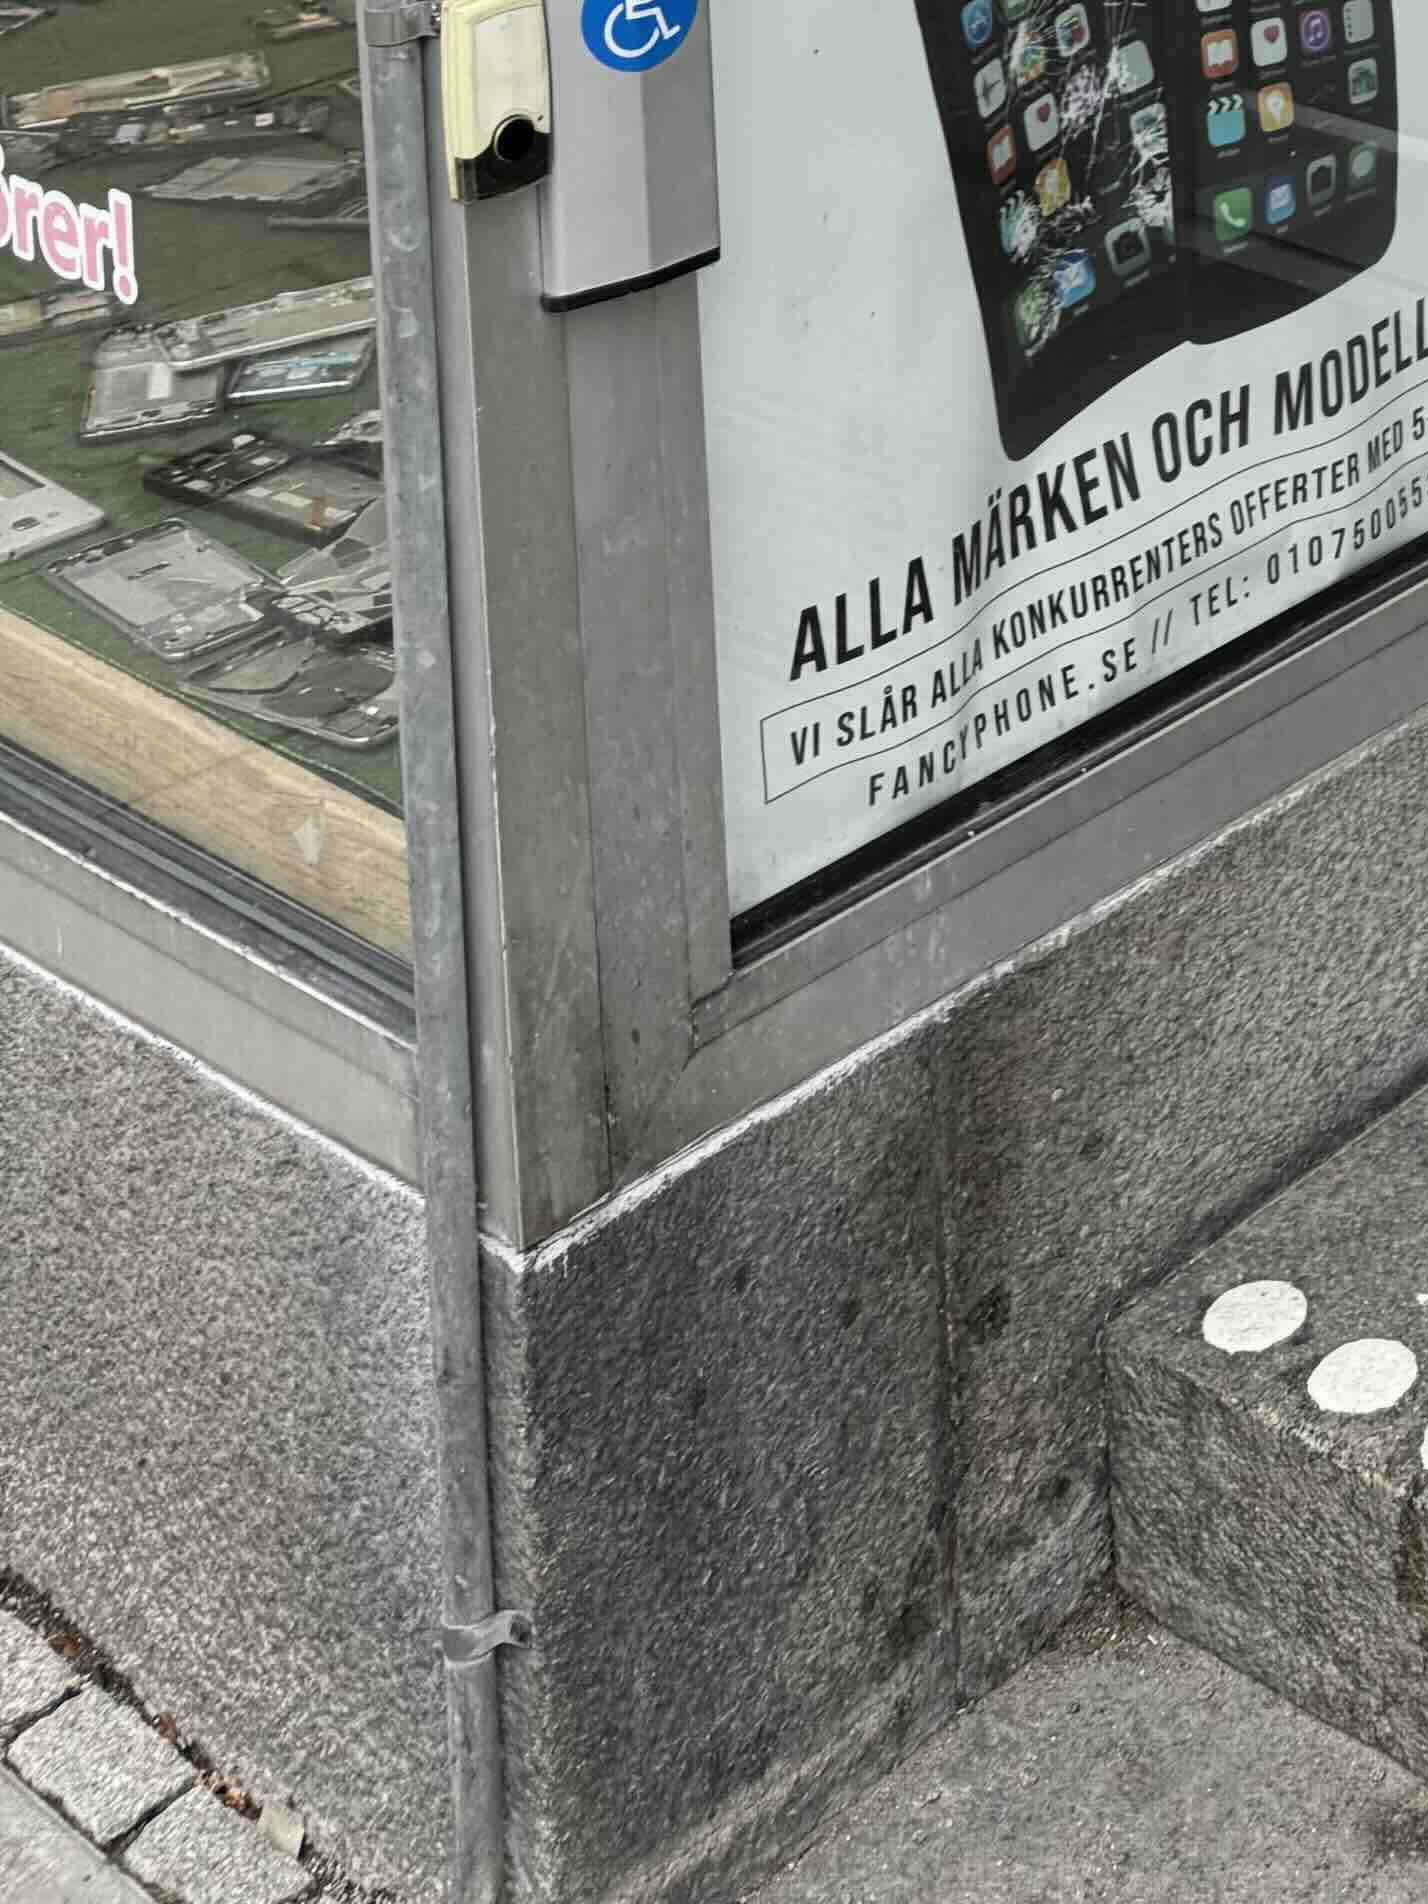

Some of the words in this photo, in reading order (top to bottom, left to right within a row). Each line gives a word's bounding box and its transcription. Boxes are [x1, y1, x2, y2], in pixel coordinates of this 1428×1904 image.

[788, 556, 934, 684] ALLA
[952, 432, 1142, 608] MÄRKEN
[1150, 382, 1251, 485] OCH
[788, 723, 825, 769] VI
[835, 679, 920, 749] SLÅR
[930, 641, 985, 710] ALLA
[990, 511, 1224, 663] KONKURRENTERS
[1229, 447, 1361, 532] OFFERTER
[1365, 421, 1406, 473] MED
[866, 632, 1141, 809] FANCYPHONE.SE
[1188, 570, 1253, 629] TEL:
